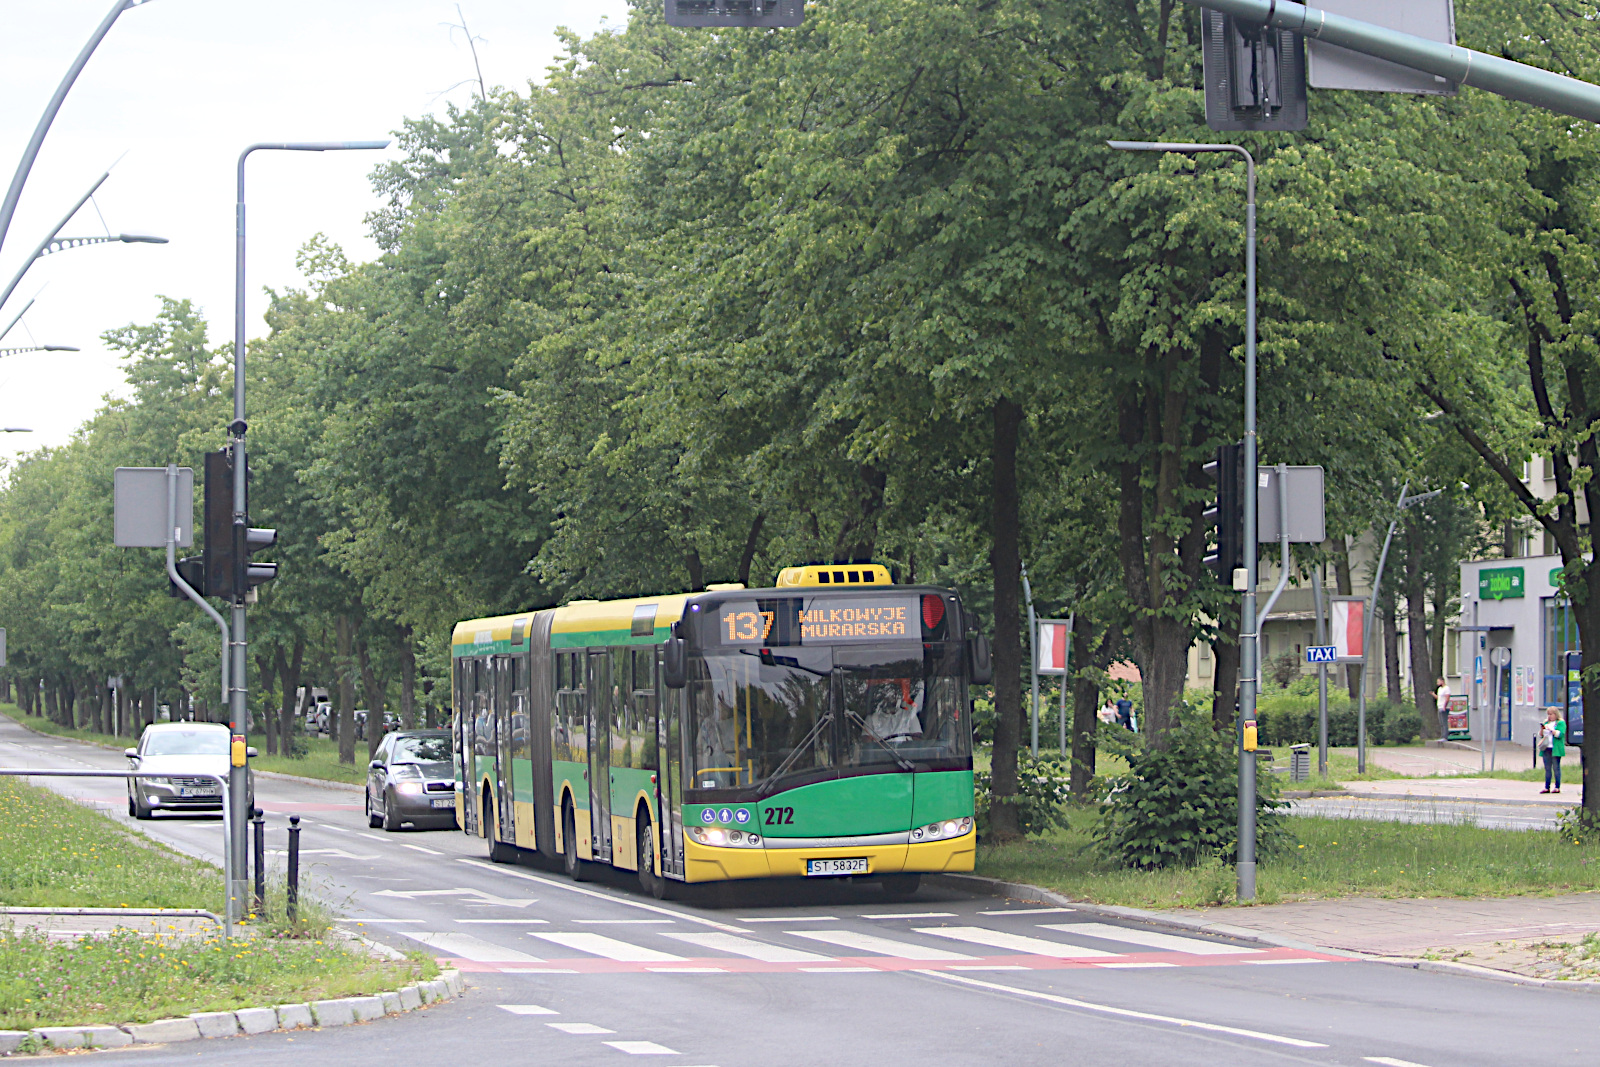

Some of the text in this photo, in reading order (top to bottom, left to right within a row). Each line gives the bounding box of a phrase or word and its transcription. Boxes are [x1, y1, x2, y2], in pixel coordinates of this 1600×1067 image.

[798, 607, 906, 623] WILKOWYJE
[723, 611, 775, 640] 137
[801, 621, 905, 638] MURARSKA
[1308, 647, 1336, 661] TAXI
[765, 806, 794, 825] 272
[814, 860, 865, 872] ST 5832F
